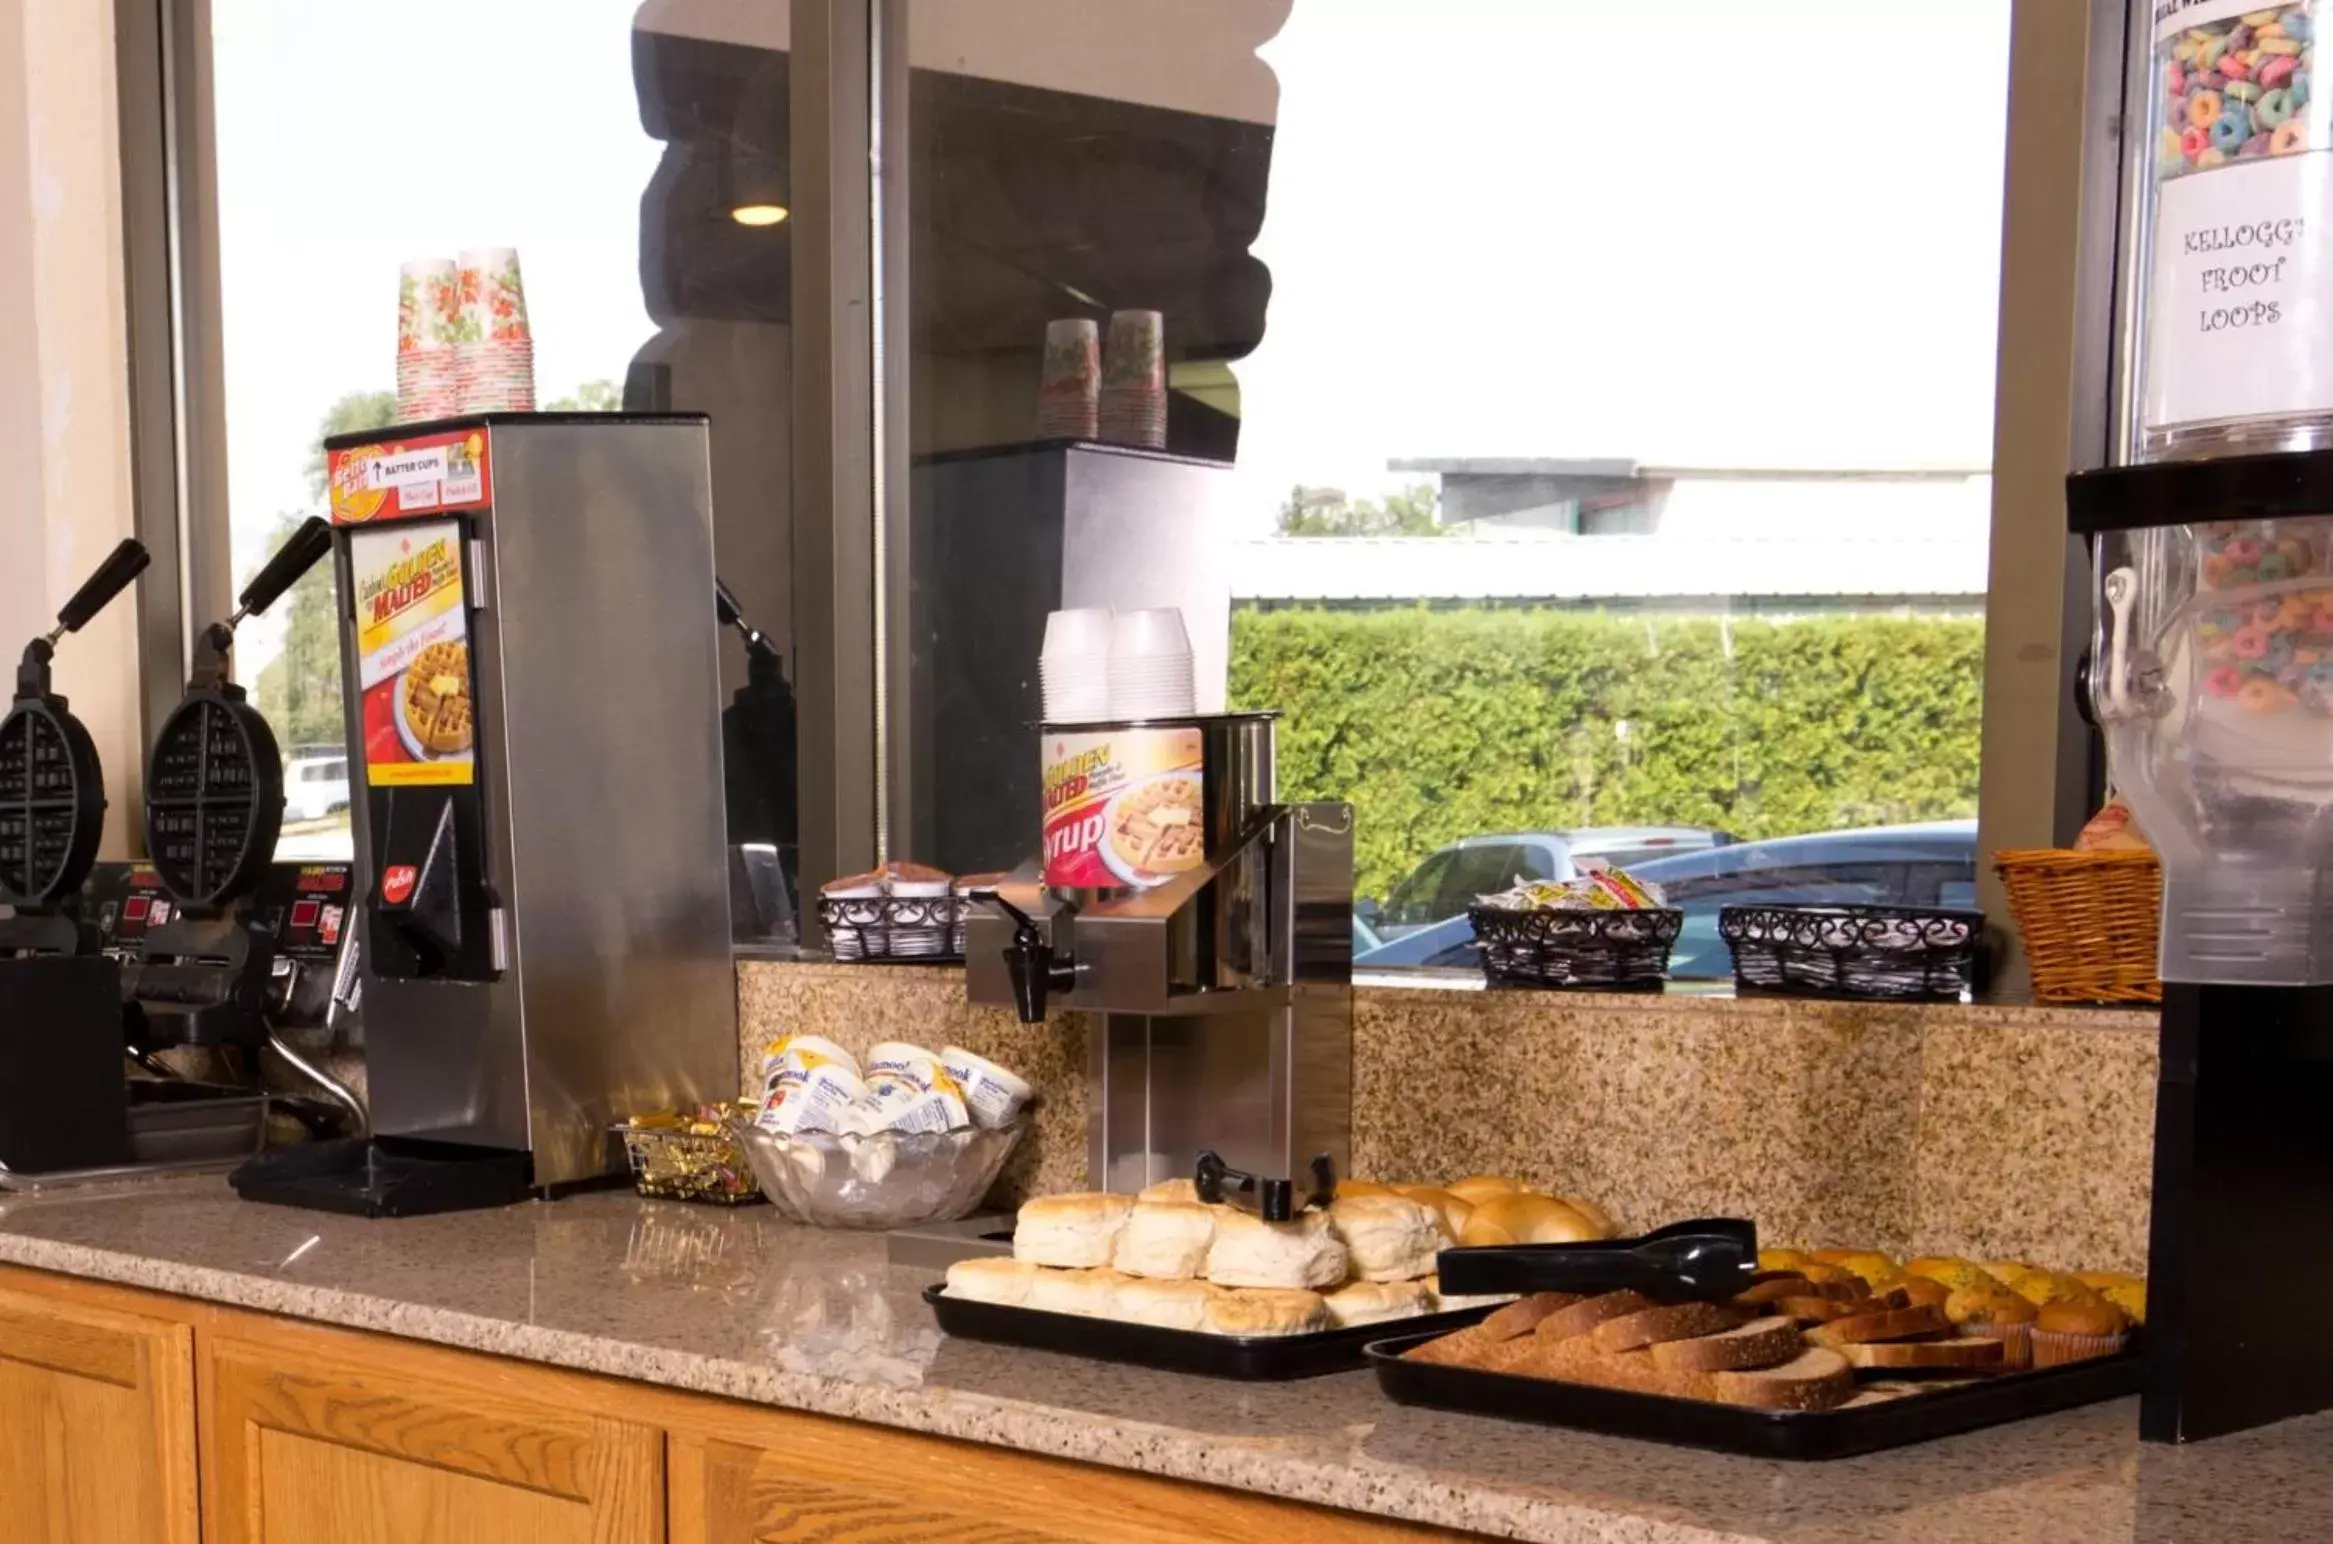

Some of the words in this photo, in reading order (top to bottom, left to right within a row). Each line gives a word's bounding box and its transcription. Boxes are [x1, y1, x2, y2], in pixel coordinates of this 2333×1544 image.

[2202, 256, 2287, 293] FROOT
[2200, 299, 2281, 332] LOOPS
[385, 462, 416, 476] BATTER
[417, 458, 439, 472] CUPS
[374, 571, 432, 623] MALTED
